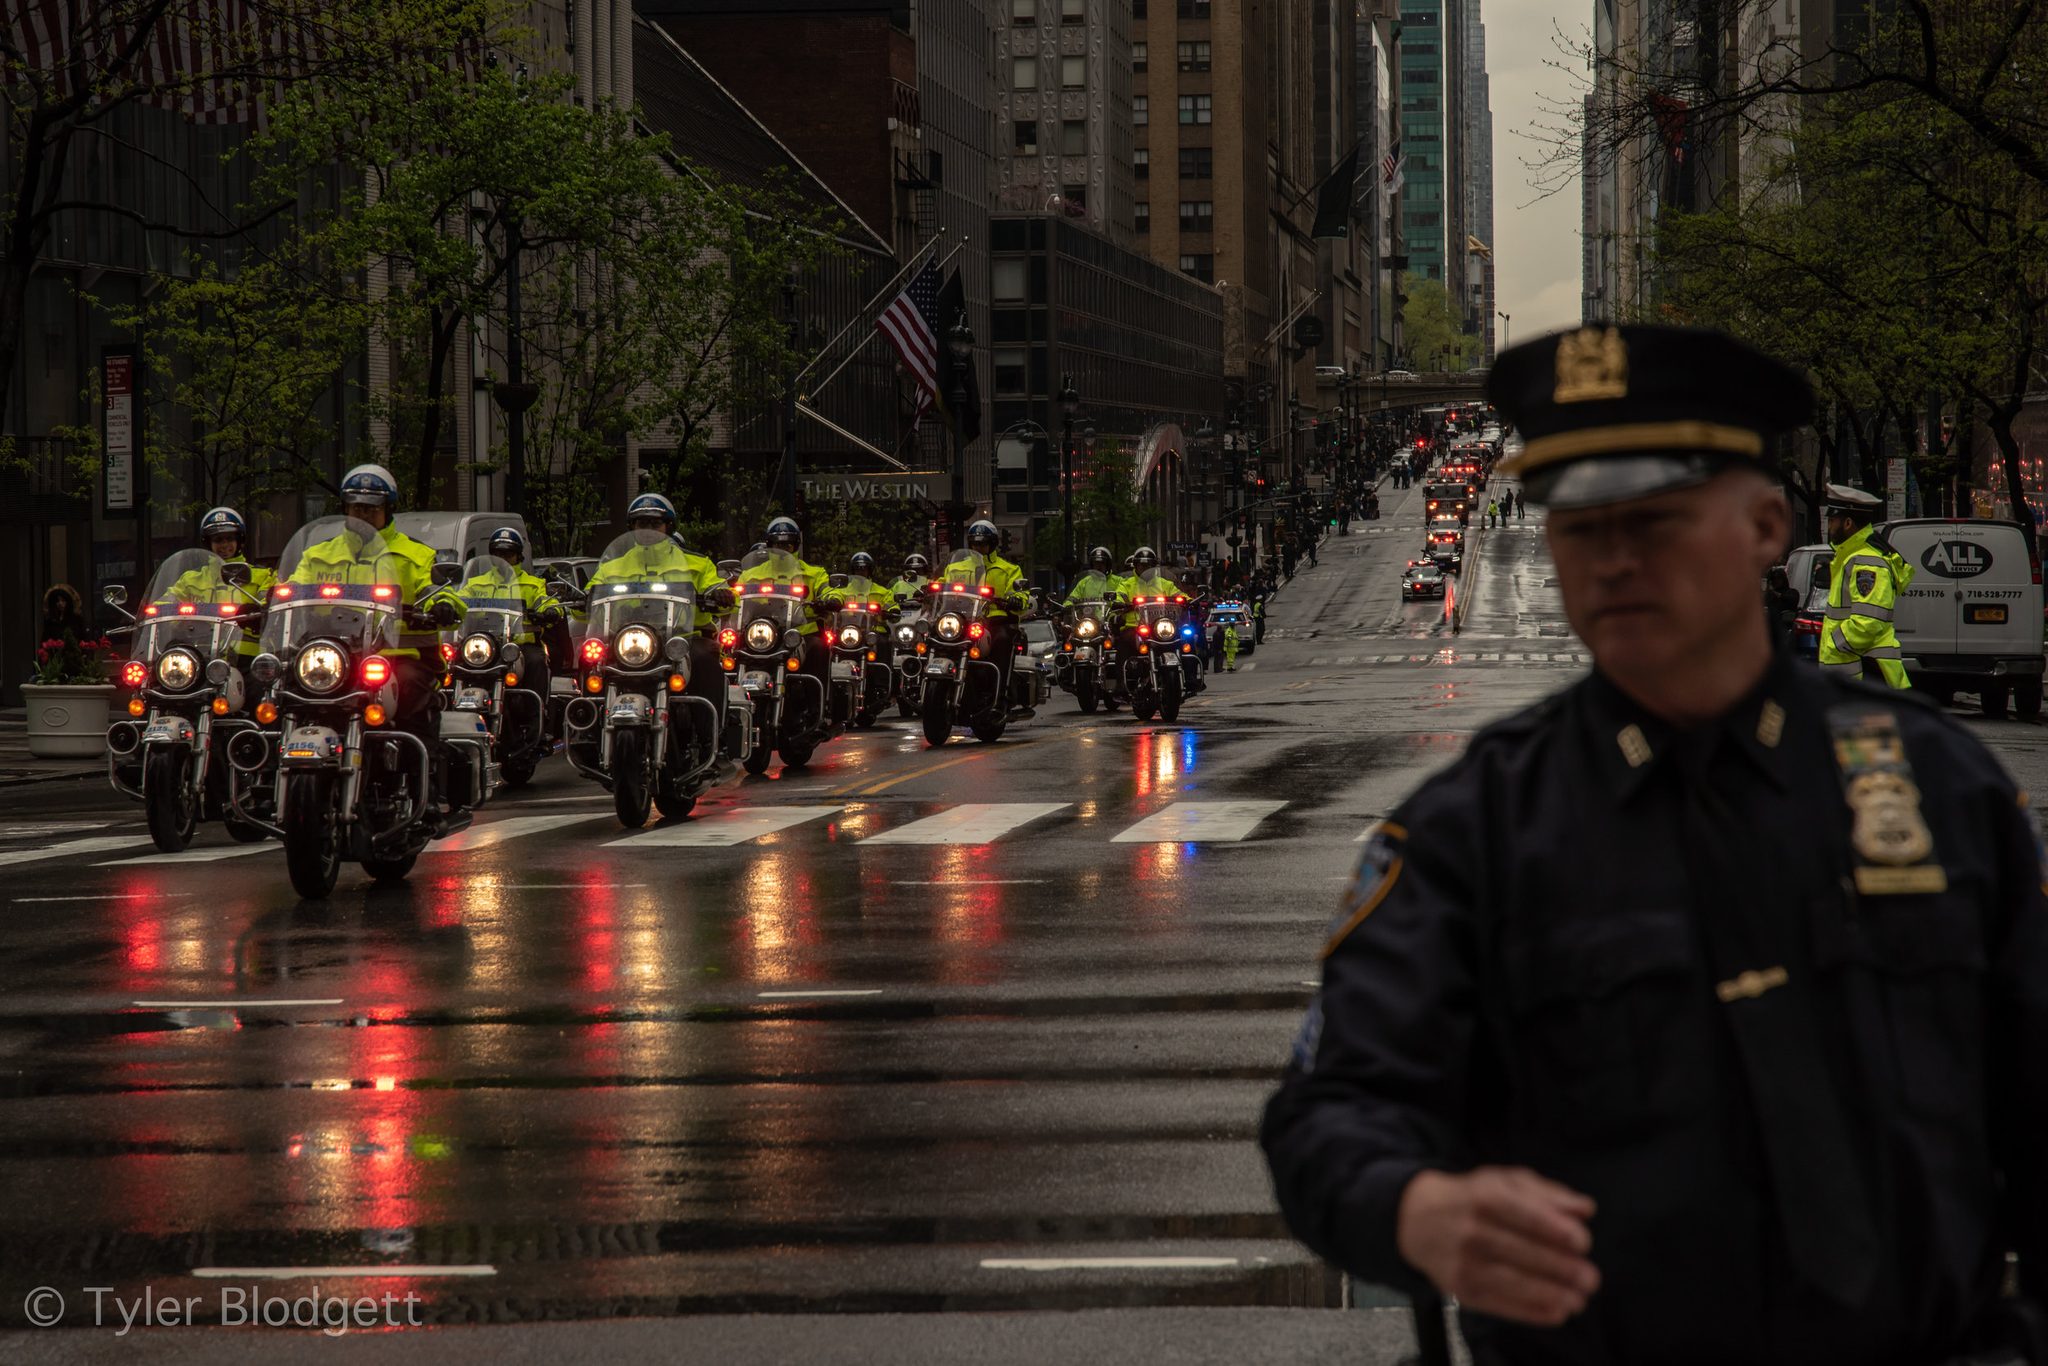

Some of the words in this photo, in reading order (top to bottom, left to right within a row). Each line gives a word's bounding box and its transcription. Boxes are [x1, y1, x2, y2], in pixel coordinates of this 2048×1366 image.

[801, 480, 842, 499] THE
[844, 480, 927, 499] WESTIN
[1927, 538, 1983, 572] ALL
[317, 571, 342, 581] NYPD
[1967, 589, 2022, 598] 718-528-7777
